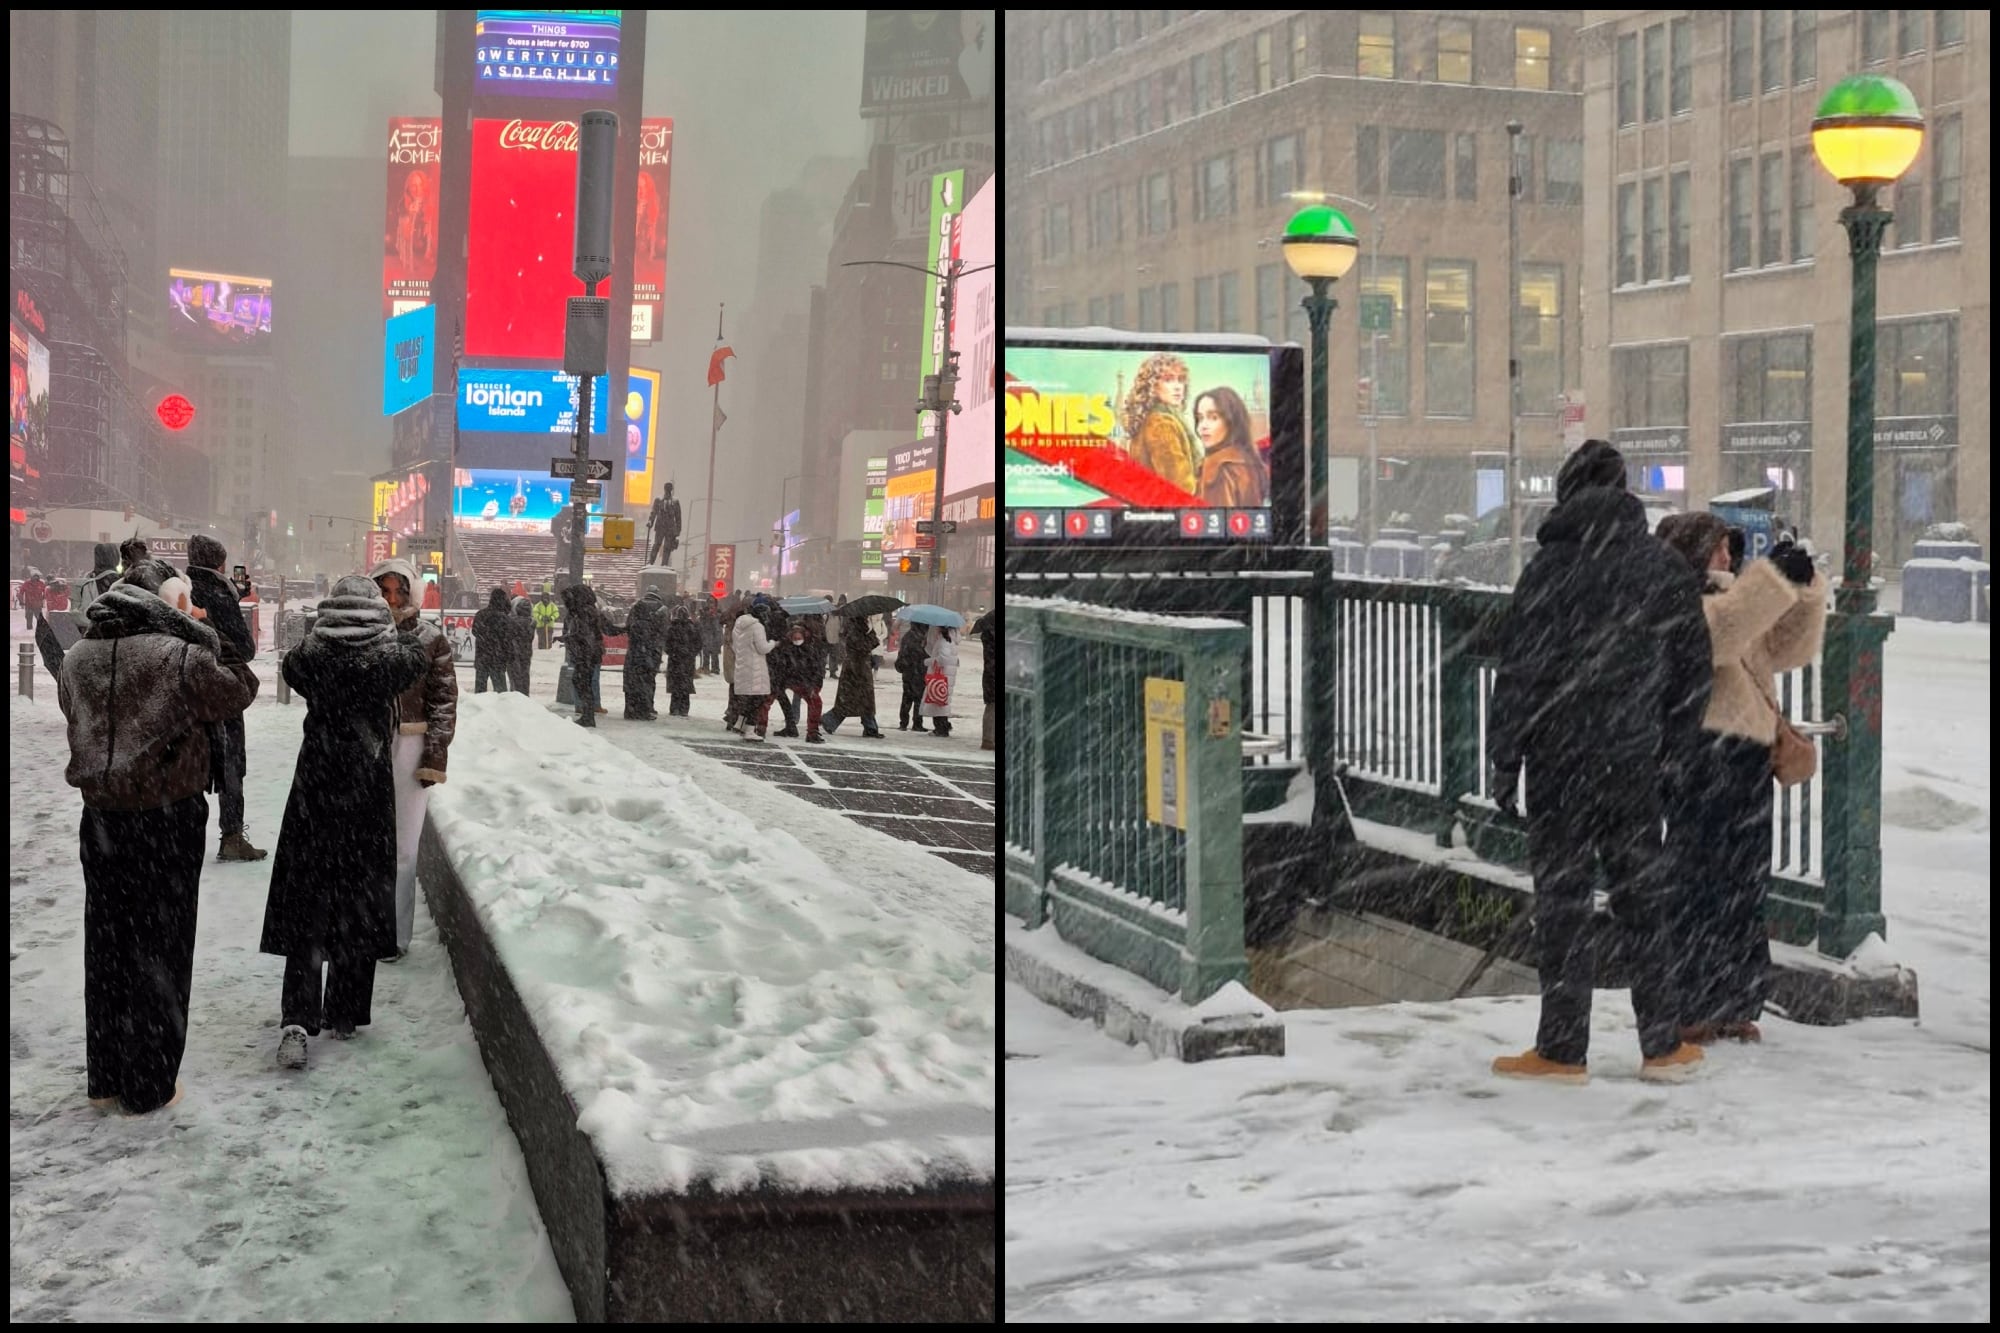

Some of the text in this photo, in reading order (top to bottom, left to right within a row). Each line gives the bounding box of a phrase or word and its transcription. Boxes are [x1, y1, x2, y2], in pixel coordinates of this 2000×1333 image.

[532, 25, 567, 35] THINGS
[507, 37, 530, 46] Guess
[537, 39, 557, 47] letter
[558, 39, 569, 48] for
[570, 40, 590, 49] $700
[390, 149, 441, 164] WOMEN
[905, 142, 960, 176] LITTLE
[466, 382, 543, 407] Ionian
[488, 405, 526, 417] Islands
[1023, 513, 1056, 530] 3 4
[1188, 513, 1219, 530] 3 3
[1255, 513, 1266, 527] 3
[373, 534, 389, 563] tkts
[1751, 532, 1769, 562] P
[714, 546, 732, 579] tkts
